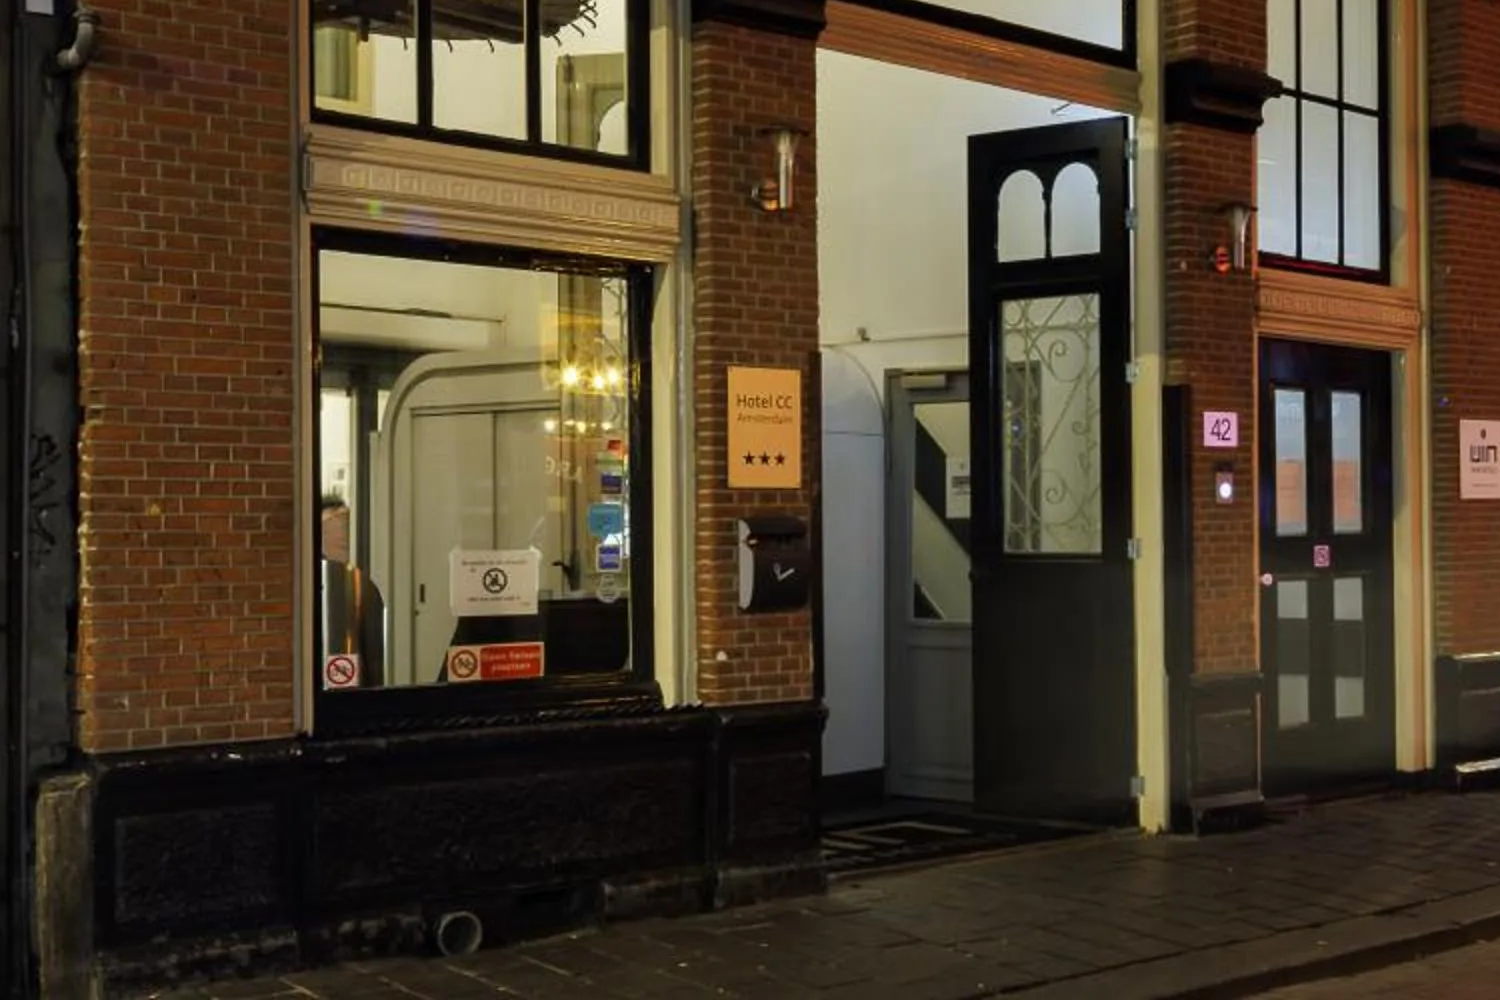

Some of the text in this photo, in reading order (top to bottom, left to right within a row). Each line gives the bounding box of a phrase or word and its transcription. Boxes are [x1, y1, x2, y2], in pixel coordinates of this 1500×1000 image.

[736, 393, 793, 409] Hotel CC
[1211, 418, 1231, 441] 42
